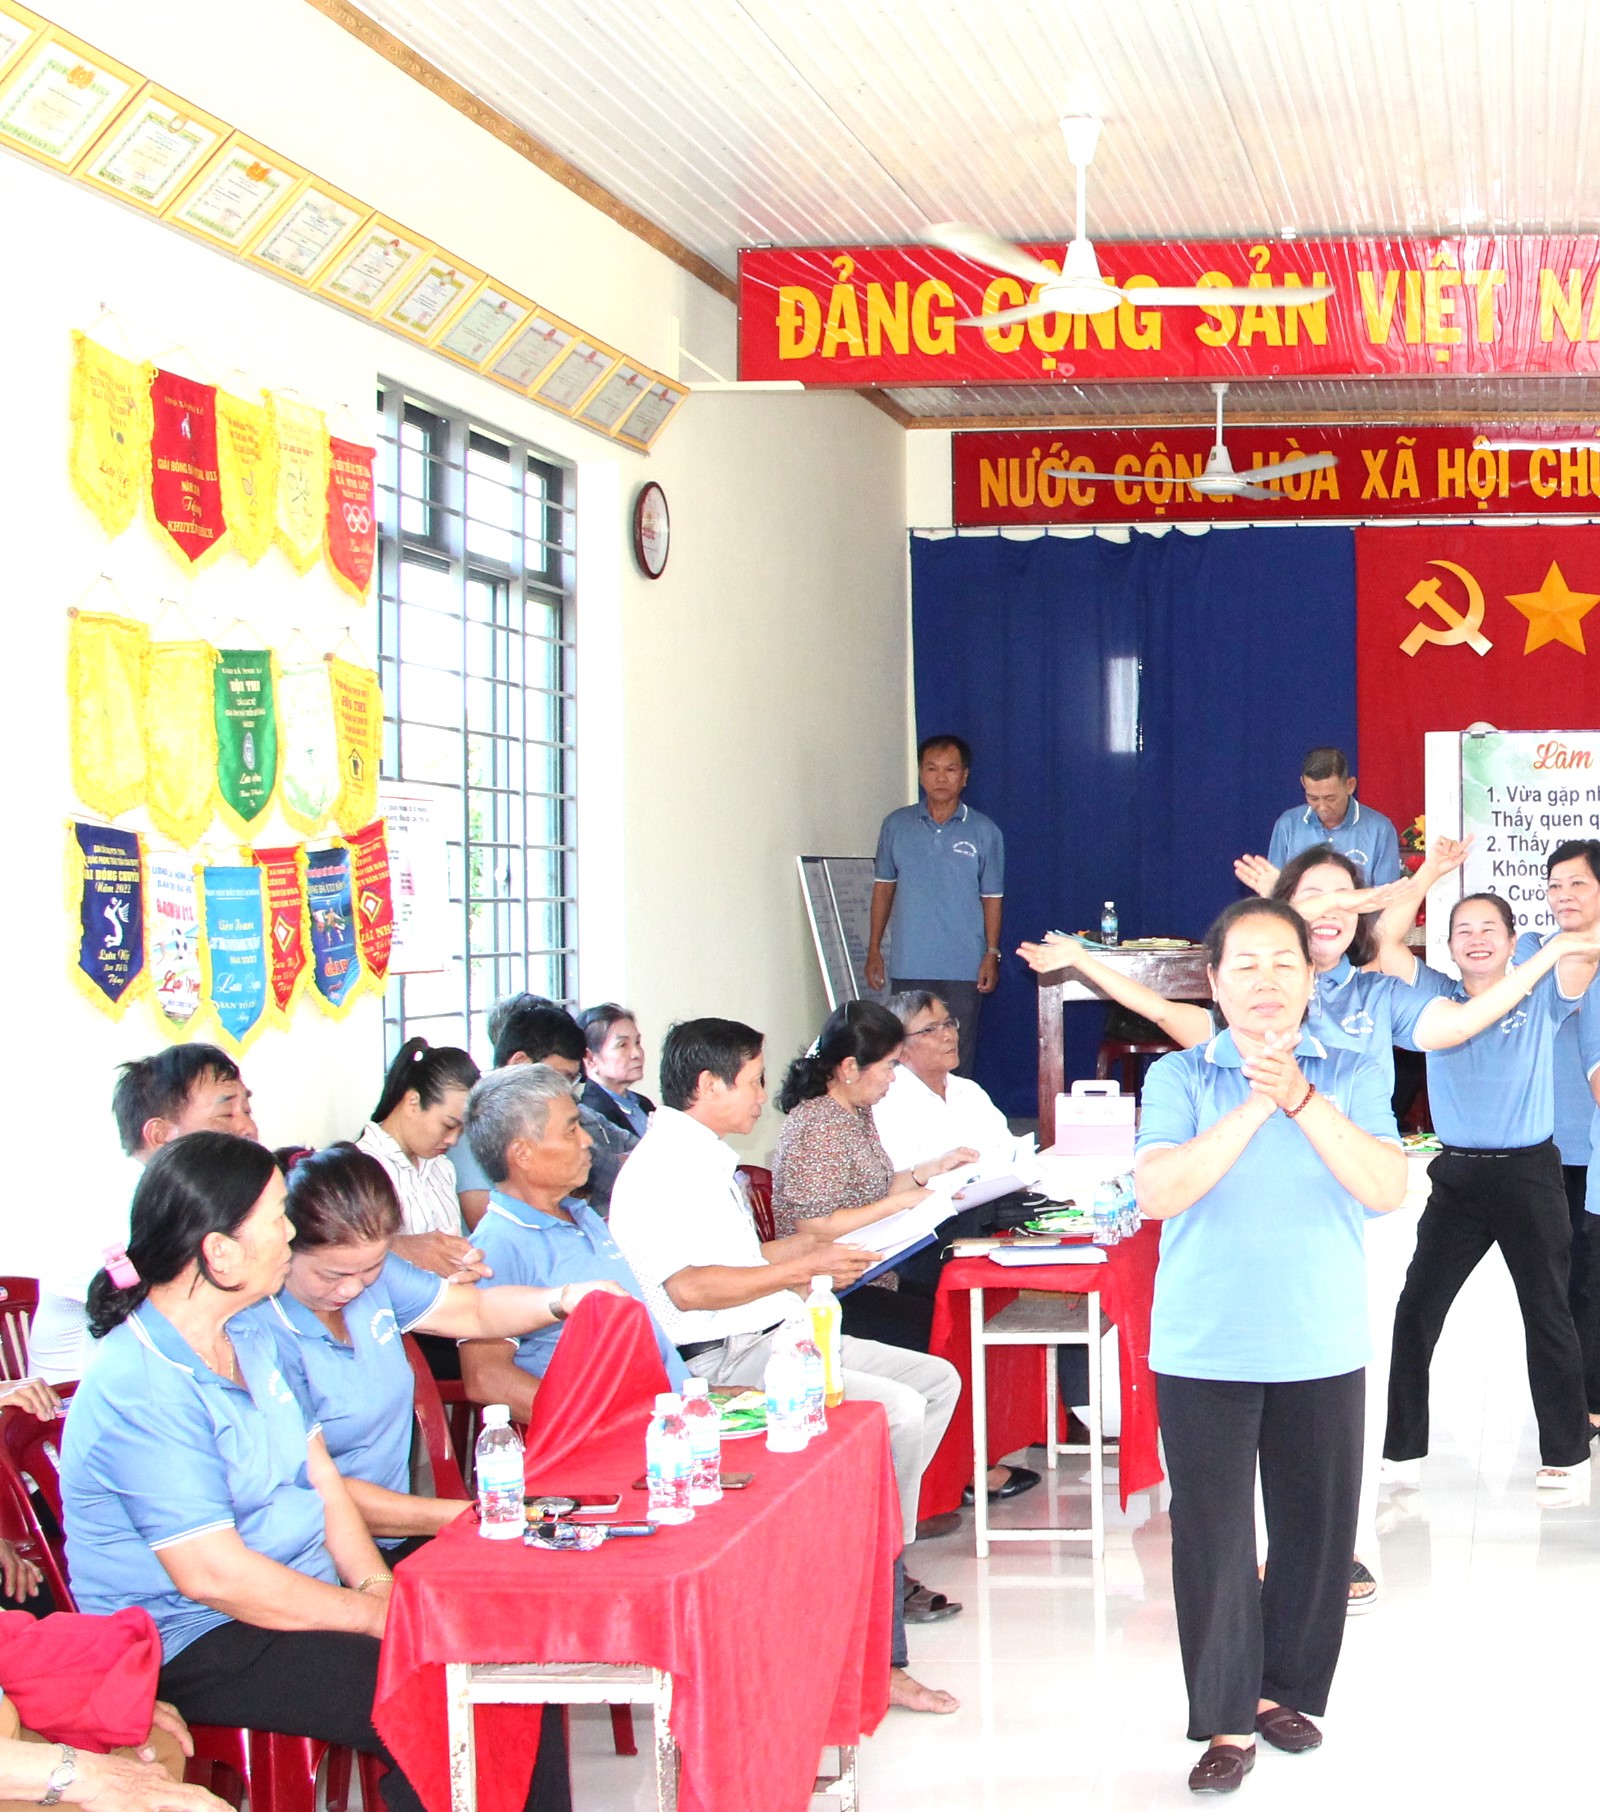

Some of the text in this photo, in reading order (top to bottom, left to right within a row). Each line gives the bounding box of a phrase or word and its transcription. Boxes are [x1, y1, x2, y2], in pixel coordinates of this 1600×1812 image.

[776, 255, 956, 360] ĐẢNG
[982, 259, 1162, 370] CỘNG
[1195, 245, 1327, 346] SẢN
[1357, 253, 1505, 362] VIỆT
[979, 442, 1096, 508] NƯỚC
[1360, 435, 1420, 499] XÃ
[1438, 434, 1509, 509] HỘI
[1533, 740, 1594, 769] Làm
[1486, 788, 1500, 802] 1.
[1506, 786, 1542, 803] Vừa
[1547, 787, 1580, 807] gặp
[1492, 806, 1534, 831] Thấy
[1540, 812, 1583, 828] quen
[1487, 836, 1501, 852] 2.
[1507, 831, 1550, 854] Thấy
[1492, 860, 1548, 878] Không
